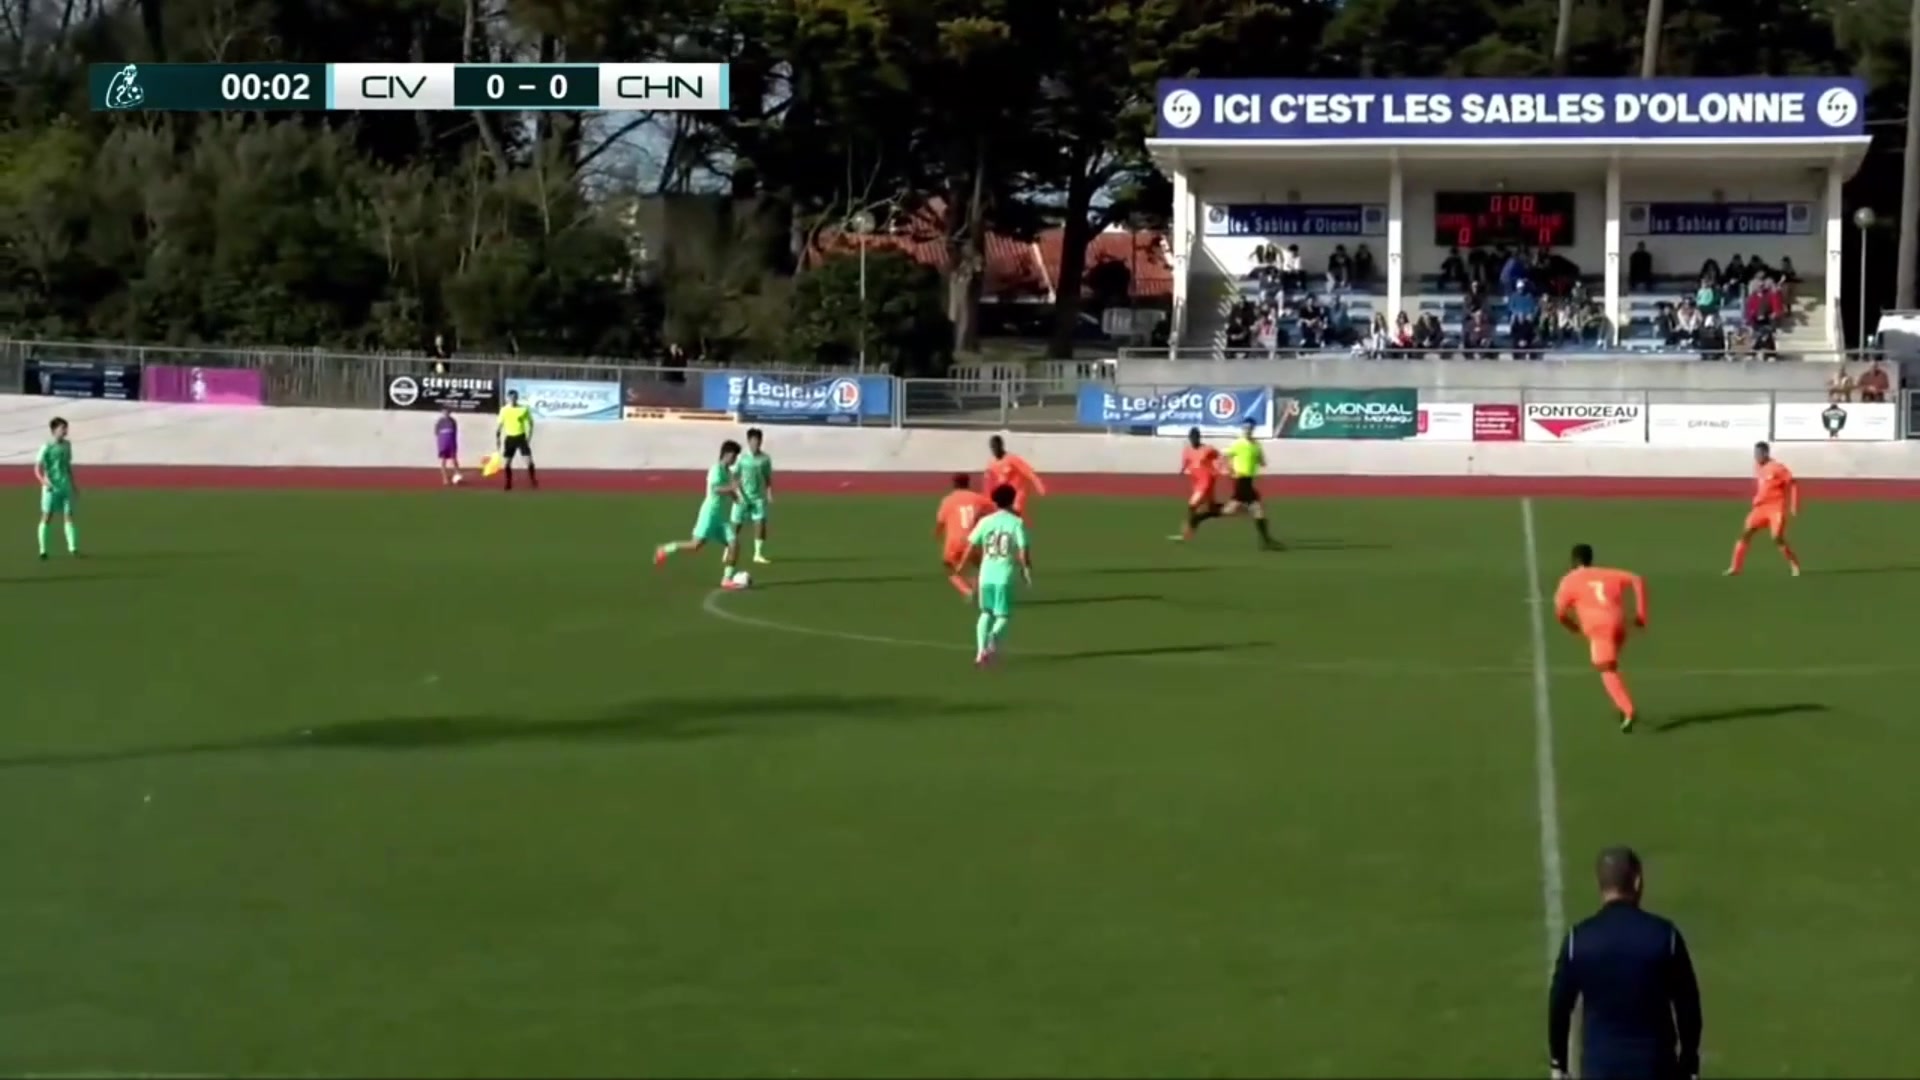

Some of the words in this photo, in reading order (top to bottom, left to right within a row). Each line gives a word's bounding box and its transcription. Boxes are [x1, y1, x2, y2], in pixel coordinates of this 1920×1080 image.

[1213, 94, 1260, 124] ICI
[1270, 94, 1375, 124] C'EST
[1383, 94, 1452, 124] LES
[1461, 93, 1605, 124] SABLES
[1615, 92, 1806, 123] D'OLONNE
[1325, 402, 1413, 415] MONDIAL
[1528, 405, 1638, 418] PONTOIZEAU
[1587, 580, 1607, 605] 7
